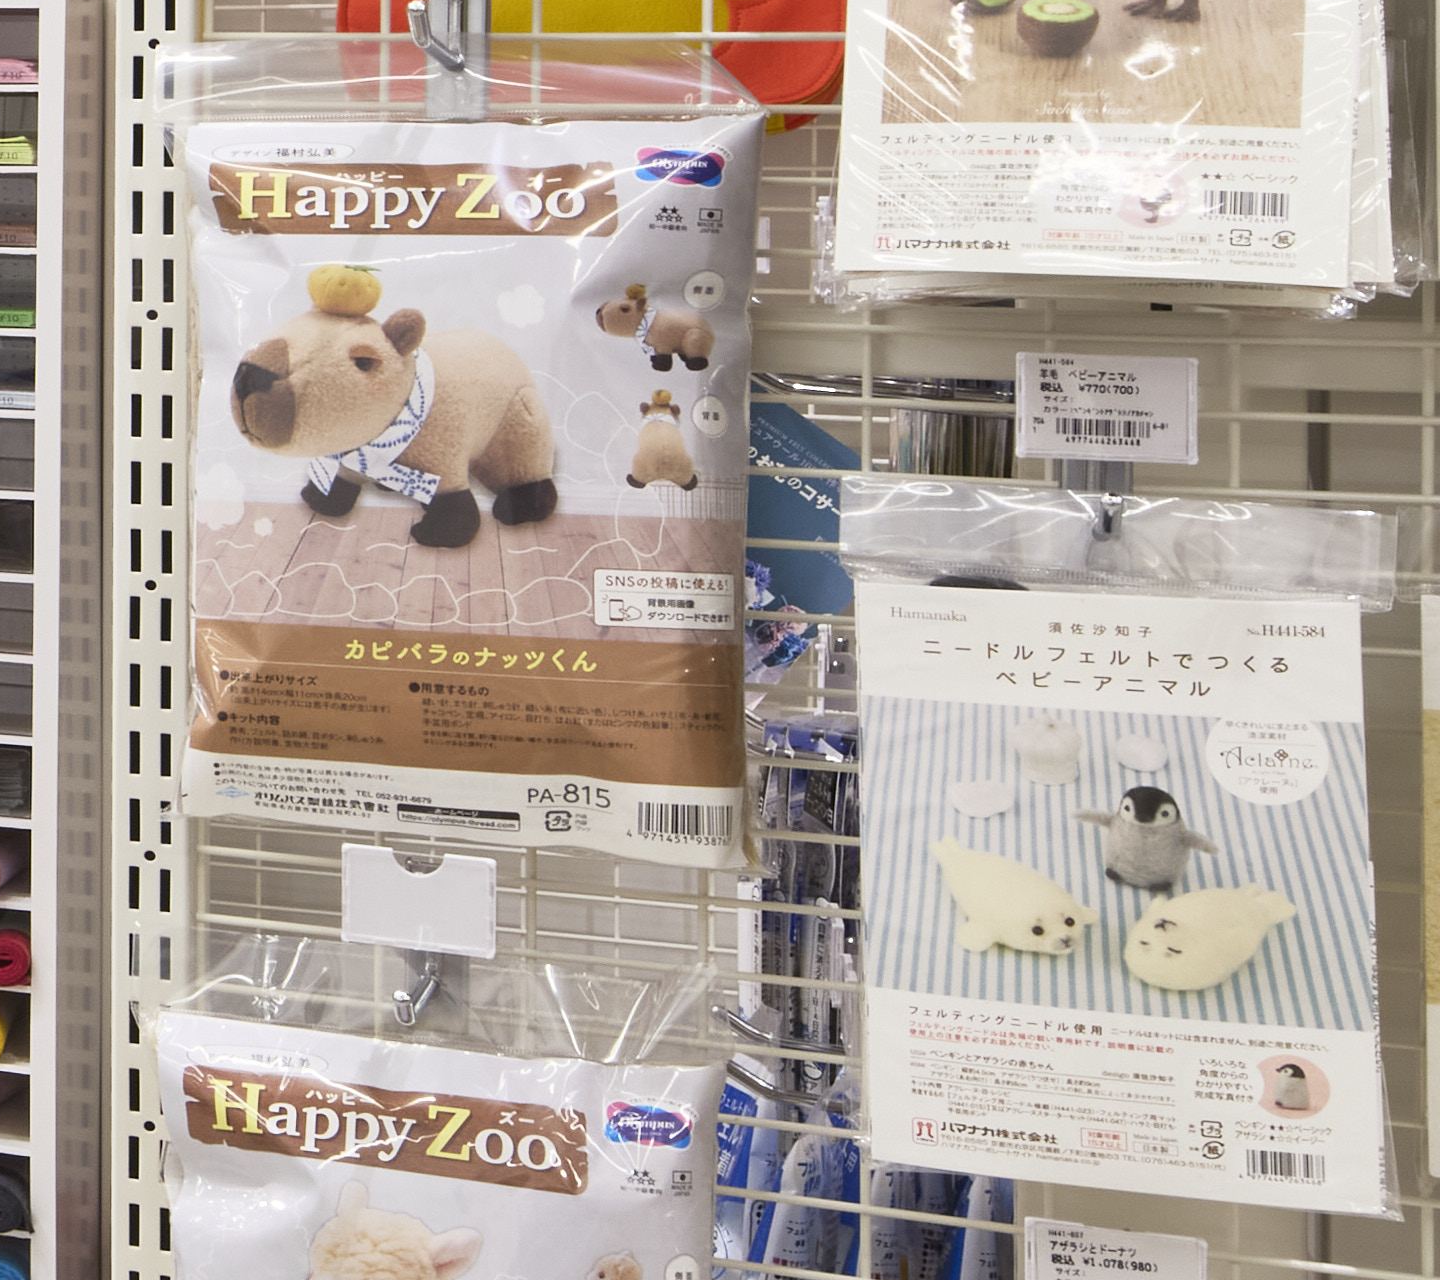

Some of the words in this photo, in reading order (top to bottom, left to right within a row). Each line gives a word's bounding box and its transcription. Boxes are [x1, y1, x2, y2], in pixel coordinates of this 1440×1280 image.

[236, 170, 446, 230] Happy
[455, 173, 586, 221] Zoo
[896, 239, 1011, 251] ハマナカ株式会社
[1039, 369, 1058, 380] 羊毛
[1069, 370, 1137, 382] ベビーアニマル
[1040, 382, 1064, 393] 税込
[1079, 384, 1140, 396] ¥770(700)
[605, 576, 730, 591] SNSの投稿に使える!
[890, 606, 967, 622] Hamanaka
[1048, 622, 1153, 638] 須佐沙知子
[344, 639, 598, 673] カピバラのナッツくん
[923, 640, 1290, 674] ニードルフェルトでつくる
[997, 671, 1211, 697] ベビーアニマル
[356, 790, 373, 799] TEL
[527, 784, 612, 809] PA-815
[908, 1006, 1103, 1036] フェルティングニードル使用
[1195, 1080, 1253, 1091] わかりやすい
[212, 1079, 415, 1162] Happy
[425, 1104, 561, 1171] Zoo
[940, 1121, 1059, 1145] ハマナカ株式会社
[1049, 1240, 1137, 1257] アザラシとドーナツ
[1051, 1254, 1075, 1266] 税込
